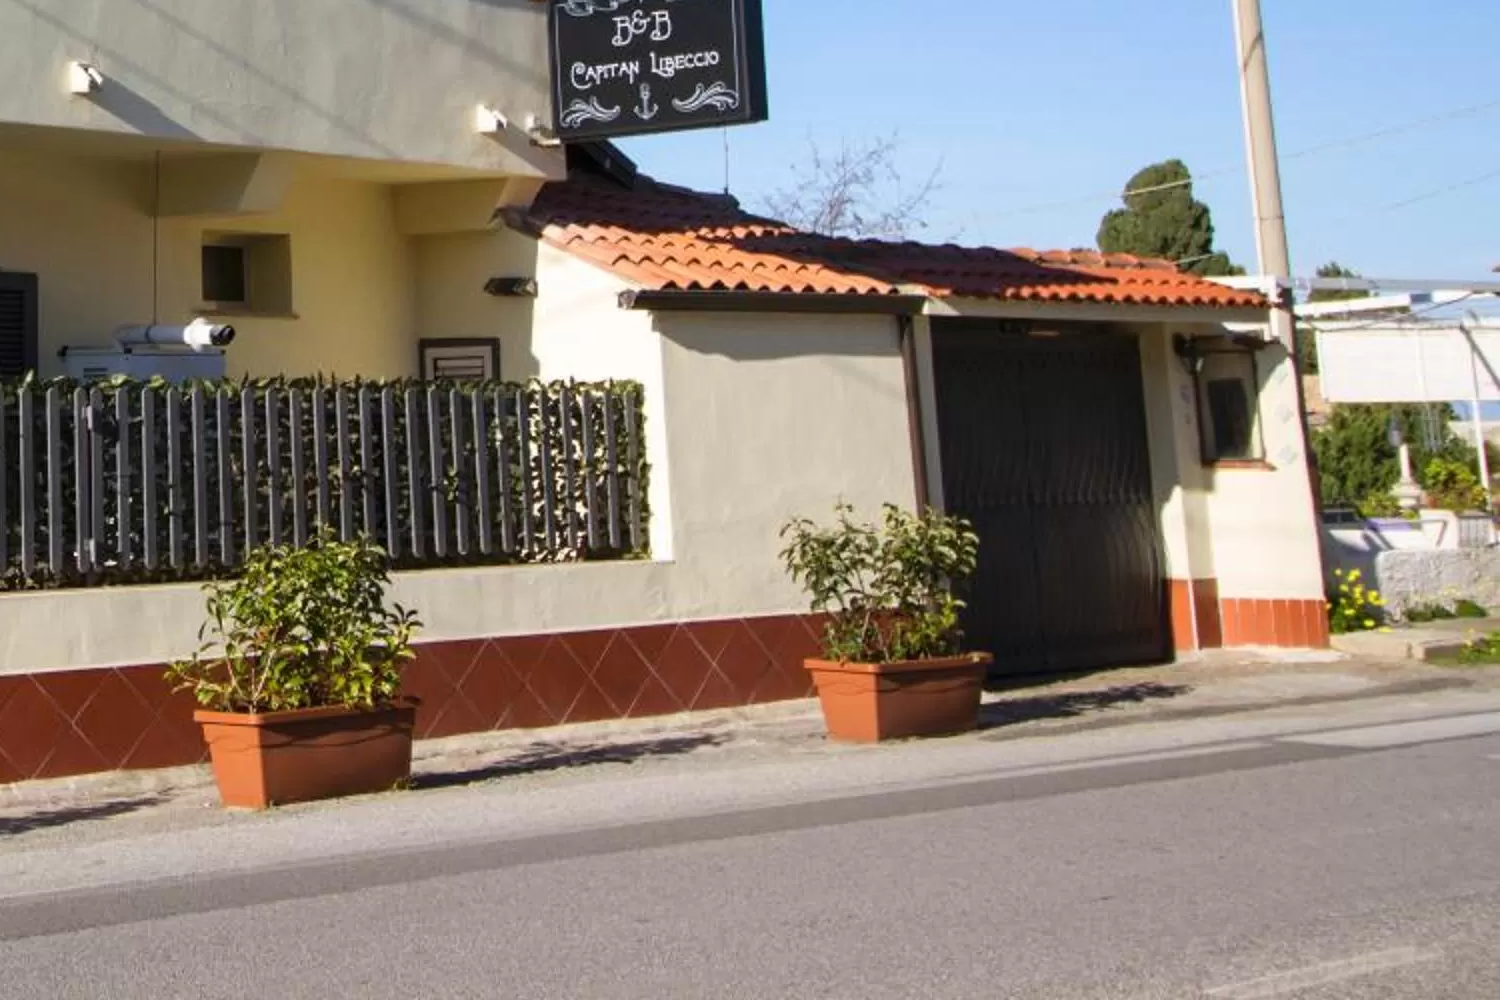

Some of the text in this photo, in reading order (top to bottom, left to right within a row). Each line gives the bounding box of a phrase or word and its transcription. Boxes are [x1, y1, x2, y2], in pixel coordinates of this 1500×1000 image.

[612, 9, 672, 47] B&B
[571, 50, 720, 89] CAPITAN LIBECCIO
